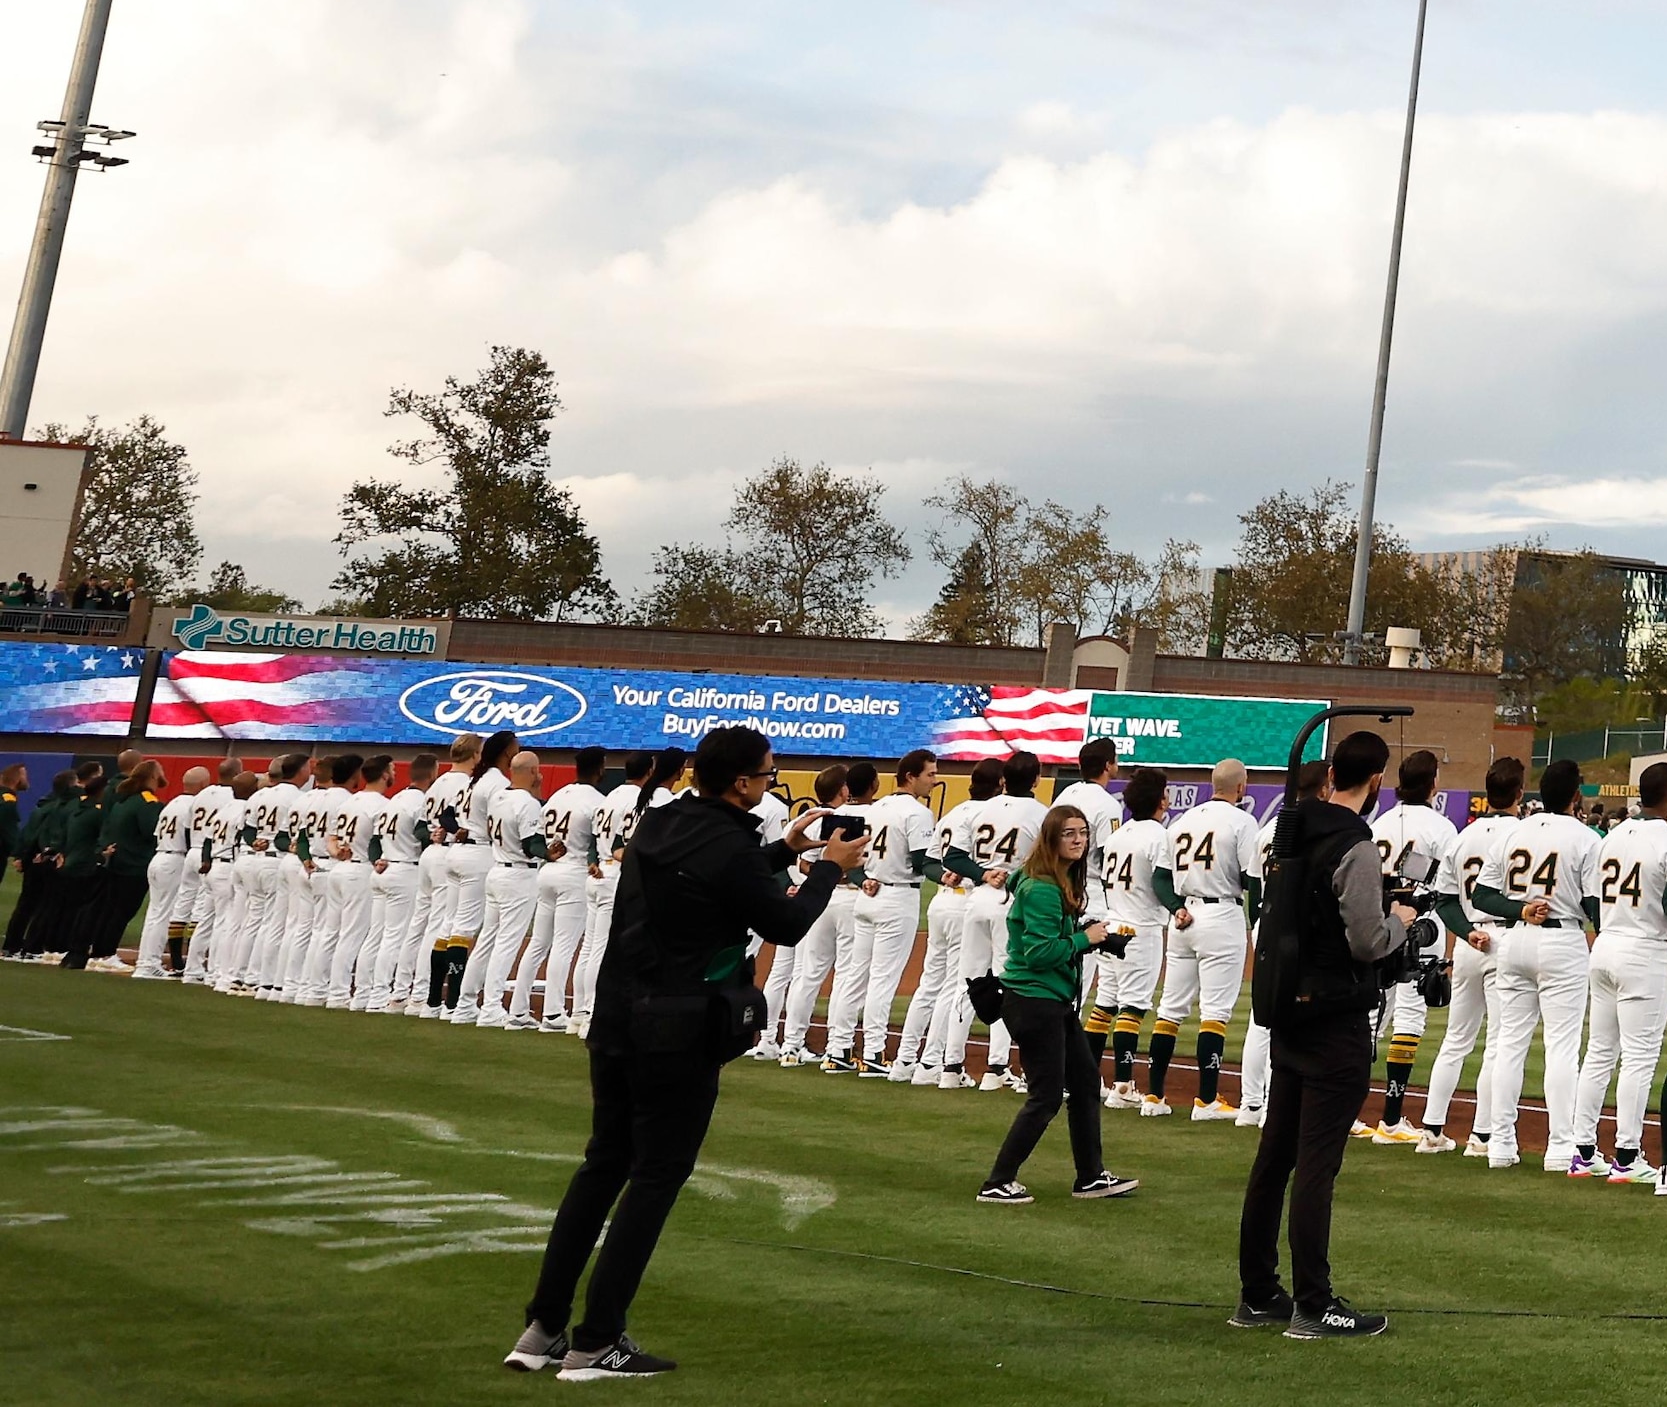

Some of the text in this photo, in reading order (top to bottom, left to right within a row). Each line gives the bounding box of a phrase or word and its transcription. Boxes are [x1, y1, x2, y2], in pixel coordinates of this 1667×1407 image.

[225, 617, 437, 653] Sutter Health
[434, 678, 553, 727] Ford
[612, 685, 899, 716] Your California Ford Dealers
[1089, 716, 1123, 735] YET
[159, 816, 177, 840] 24
[211, 820, 230, 845] 24
[257, 805, 279, 832] 24
[305, 811, 328, 838] 24
[337, 813, 359, 843] 24
[378, 812, 399, 841] 24
[545, 809, 572, 840] 24
[975, 824, 1020, 863] 24
[1176, 831, 1215, 871] 24
[1104, 852, 1134, 891] 24
[1508, 848, 1559, 897] 24
[1601, 858, 1642, 907] 24
[1321, 1312, 1356, 1329] HOKA
